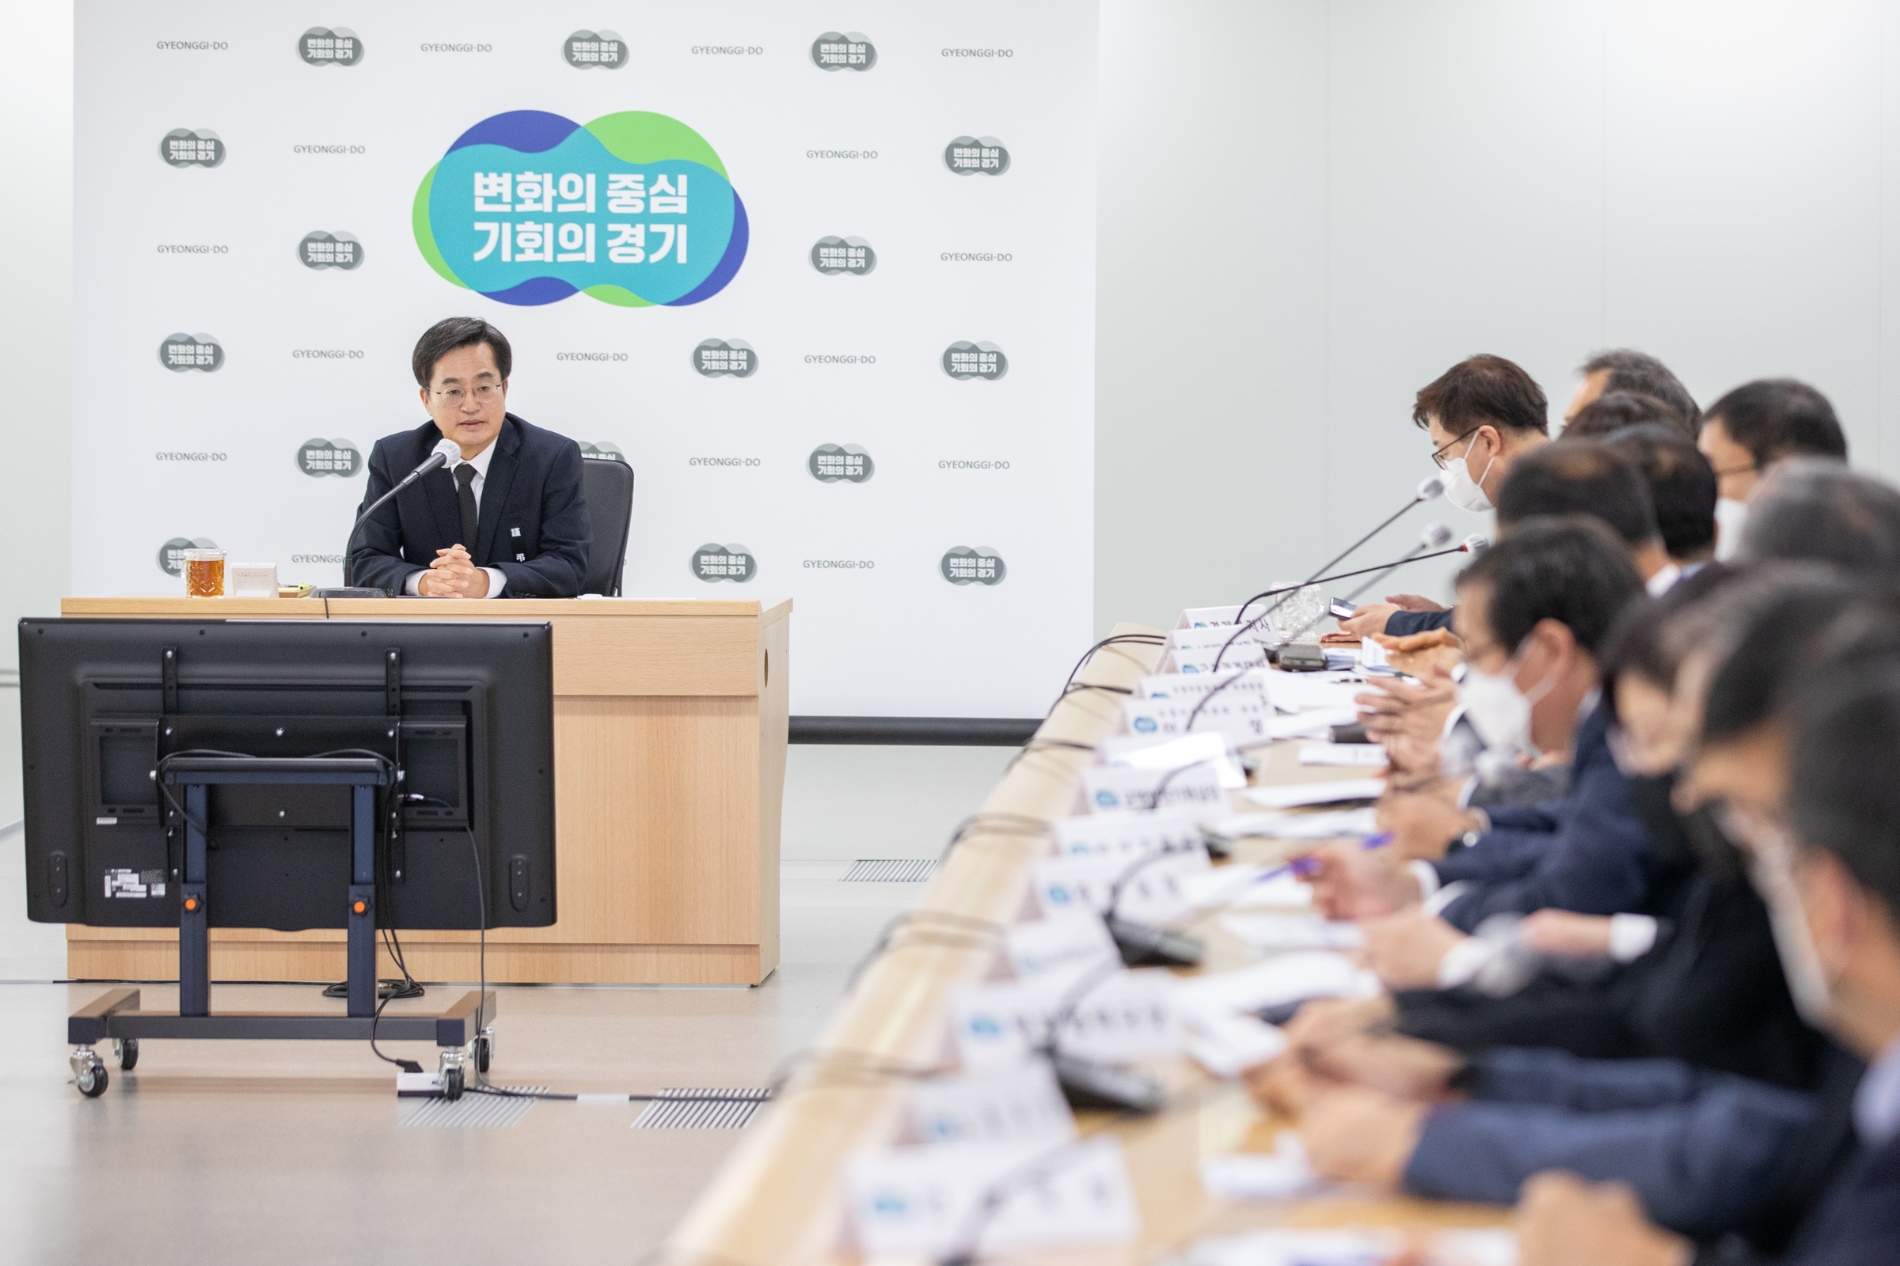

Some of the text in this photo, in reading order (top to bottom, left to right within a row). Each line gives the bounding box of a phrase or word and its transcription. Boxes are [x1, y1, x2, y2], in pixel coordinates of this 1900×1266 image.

[156, 40, 229, 51] GYEONGGI-DO
[307, 38, 353, 49] 변화의 중심
[420, 43, 493, 53] GYEONGGI-DO
[572, 41, 618, 52] 변화의 중심
[820, 43, 866, 54] 변화의 중심
[307, 48, 353, 59] 기회의 경기
[691, 45, 764, 55] GYEONGGI-DO
[941, 48, 1014, 58] GYEONGGI-DO
[572, 51, 618, 62] 기회의 경기
[820, 53, 866, 64] 기회의 경기
[169, 139, 215, 150] 변화의 중심
[293, 144, 366, 155] GYEONGGI-DO
[169, 149, 215, 160] 기회의 경기
[806, 149, 879, 160] GYEONGGI-DO
[953, 147, 999, 158] 변화의 중심
[953, 157, 999, 168] 기회의 경기
[474, 171, 688, 214] 변화의 중심
[307, 242, 353, 253] 변화의 중심
[473, 221, 688, 264] 기회의 경기
[156, 244, 229, 254] GYEONGGI-DO
[819, 247, 865, 258] 변화의 중심
[307, 252, 353, 263] 기회의 경기
[819, 257, 865, 268] 기회의 경기
[940, 252, 1013, 262] GYEONGGI-DO
[168, 344, 214, 355] 변화의 중심
[292, 349, 365, 359] GYEONGGI-DO
[168, 354, 214, 365] 기회의 경기
[556, 352, 629, 362] GYEONGGI-DO
[701, 350, 747, 361] 변화의 중심
[804, 354, 877, 364] GYEONGGI-DO
[951, 352, 997, 363] 변화의 중심
[701, 360, 747, 371] 기회의 경기
[951, 362, 997, 373] 기회의 경기
[155, 452, 228, 462] GYEONGGI-DO
[306, 449, 352, 460] 변화의 중심
[306, 459, 352, 470] 기회의 경기
[688, 457, 761, 467] GYEONGGI-DO
[817, 455, 863, 466] 변화의 중심
[938, 460, 1011, 470] GYEONGGI-DO
[817, 465, 863, 476] 기회의 경기
[291, 553, 345, 563] GYEONGGI
[700, 555, 746, 566] 변화의 중심
[949, 557, 995, 568] 변화의 중심
[802, 559, 875, 569] GYEONGGI-DO
[700, 565, 746, 576] 기회의 경기
[949, 567, 995, 578] 기회의 경기
